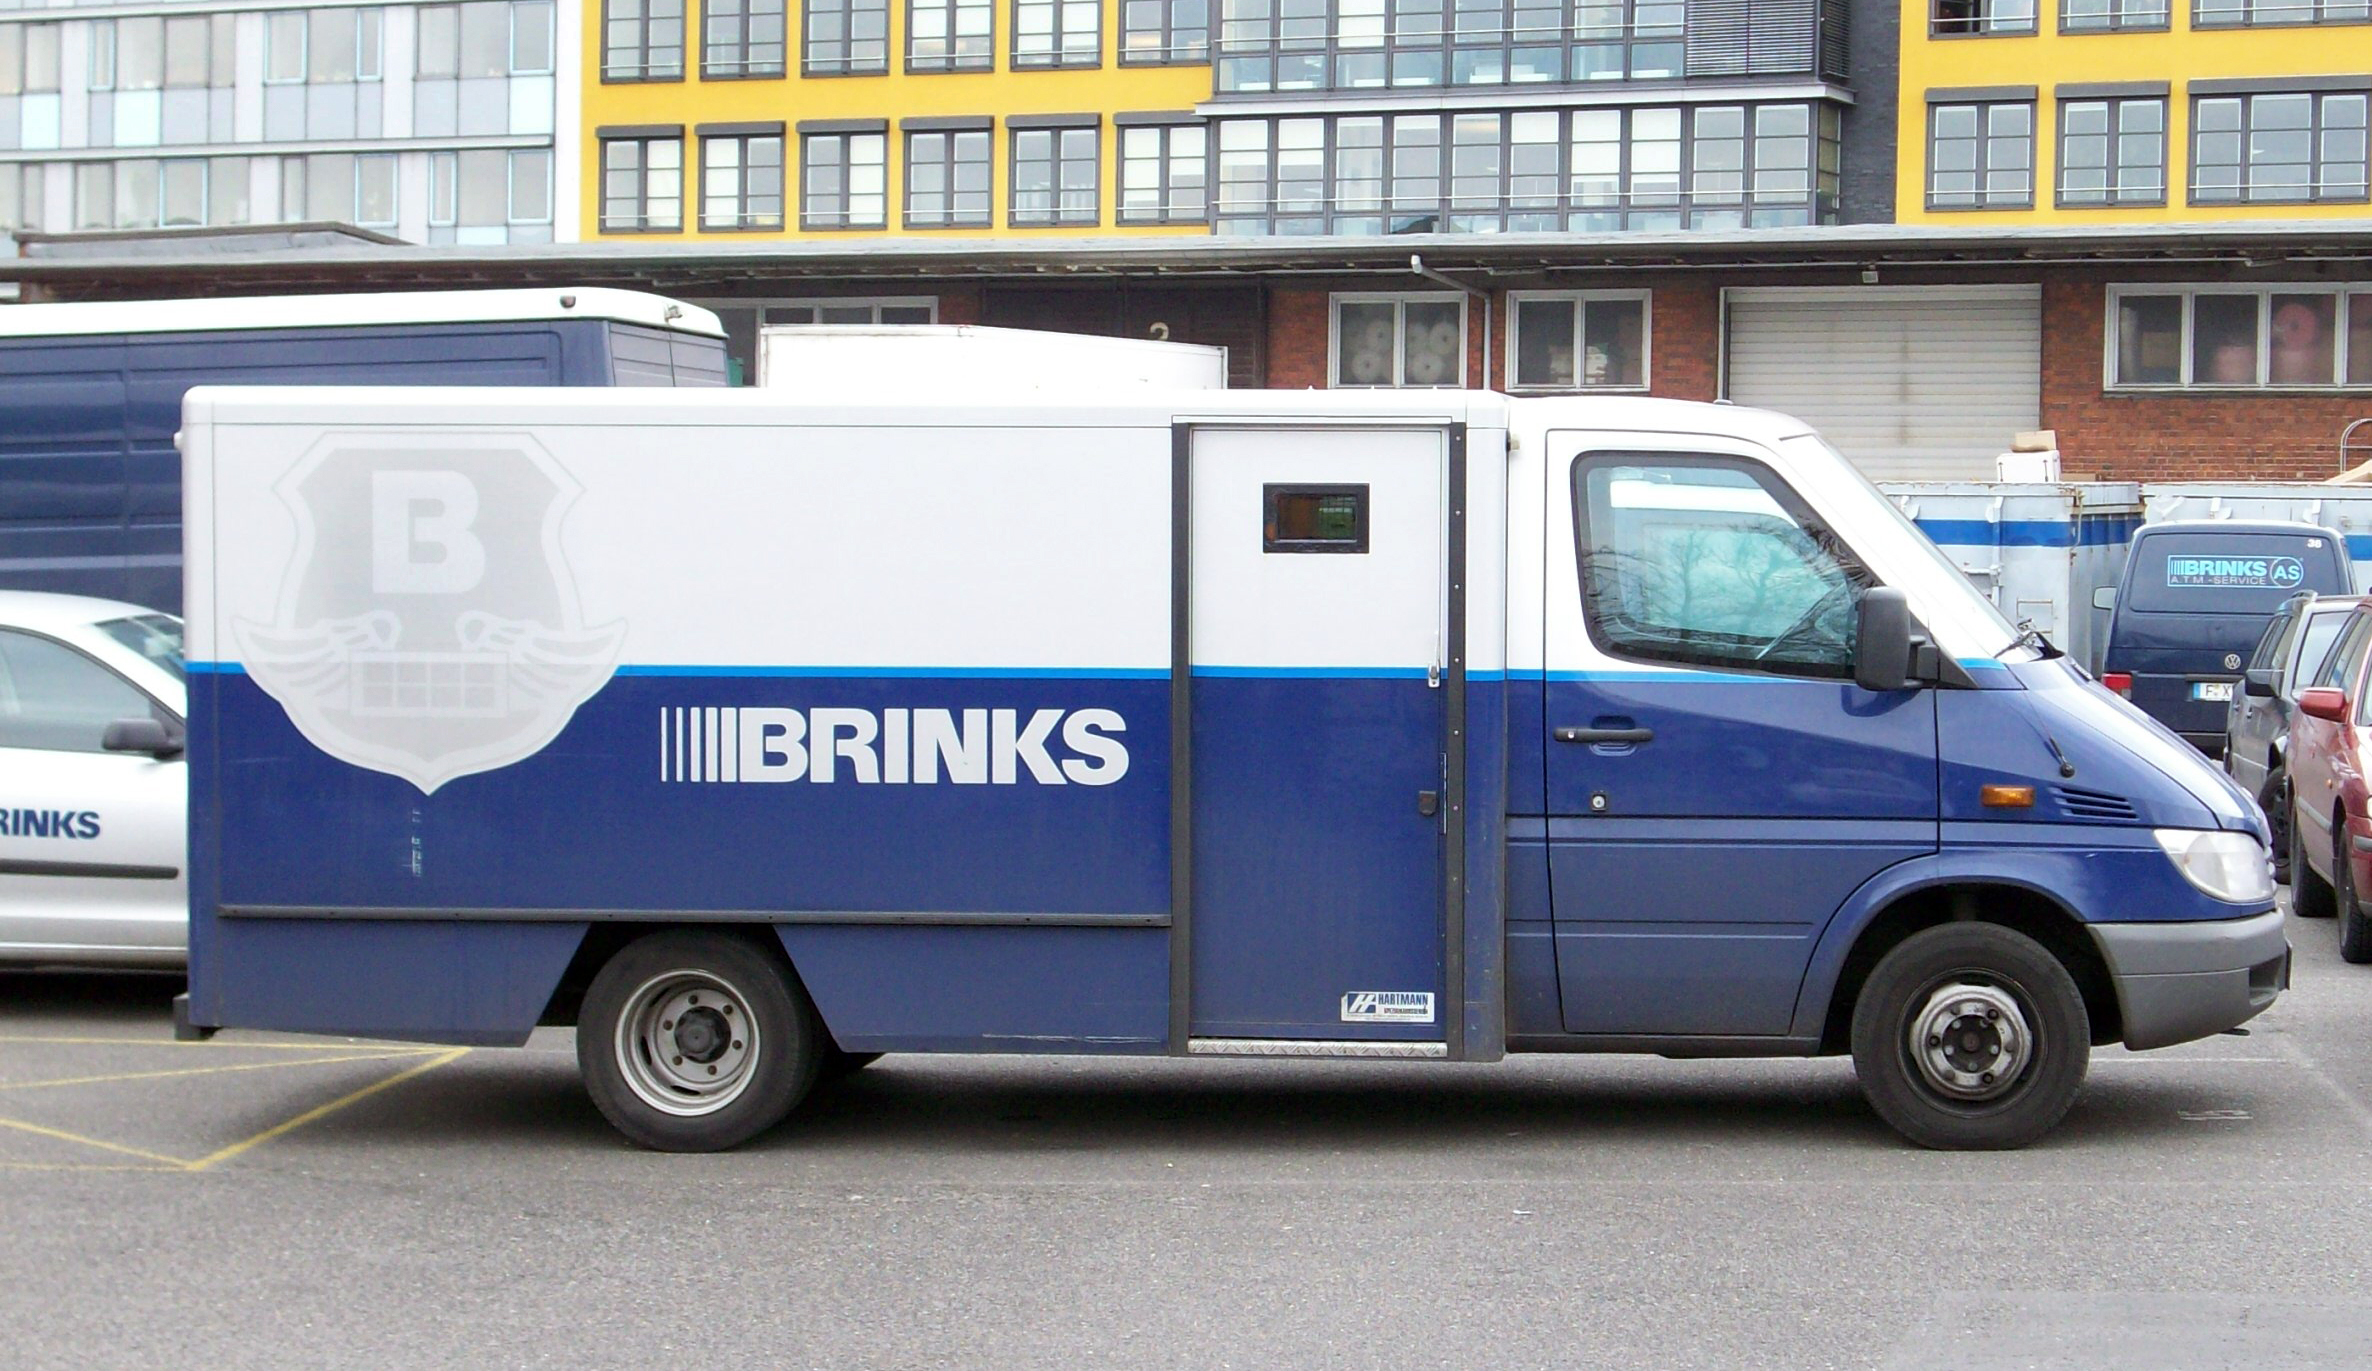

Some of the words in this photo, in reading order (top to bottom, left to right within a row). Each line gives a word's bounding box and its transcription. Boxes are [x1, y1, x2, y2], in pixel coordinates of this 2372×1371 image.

[372, 470, 485, 593] B
[2184, 559, 2267, 577] BRINKS
[2274, 565, 2300, 580] AS
[739, 707, 1130, 786] BRINKS
[1378, 993, 1429, 1005] HARTMANN
